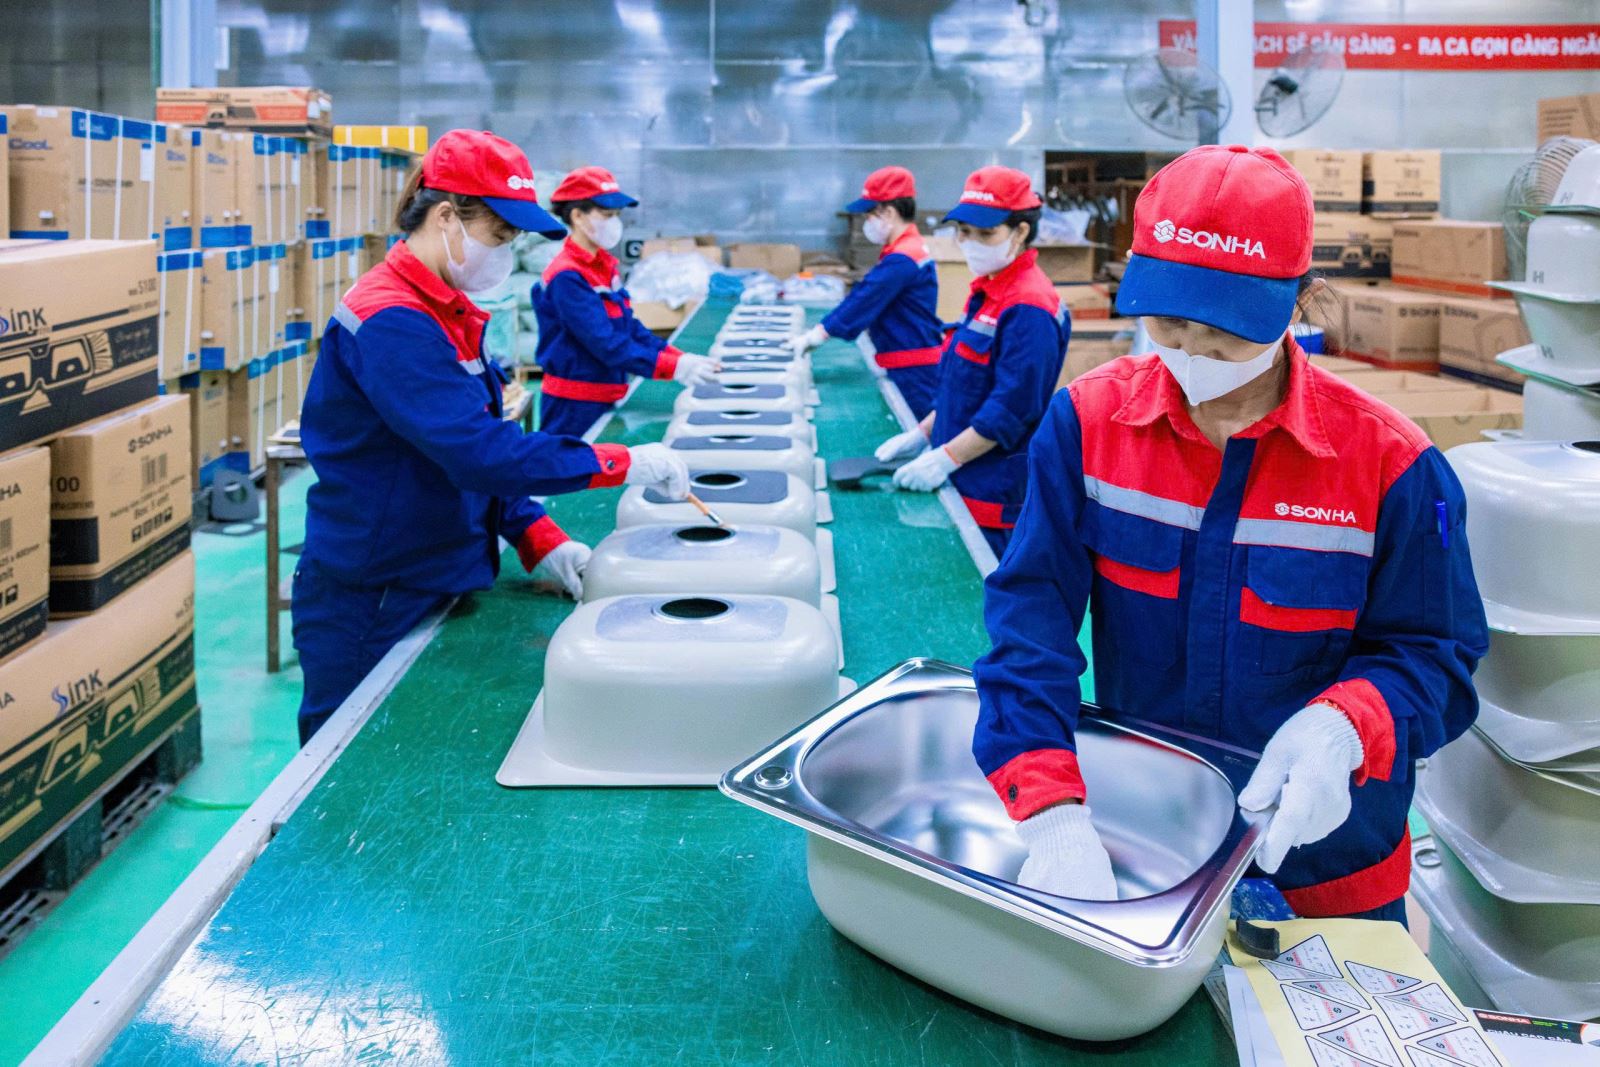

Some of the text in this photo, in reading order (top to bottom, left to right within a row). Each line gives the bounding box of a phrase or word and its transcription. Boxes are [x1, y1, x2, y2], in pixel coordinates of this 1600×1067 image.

[1348, 32, 1396, 55] SÀNG
[1418, 36, 1443, 56] RA
[1444, 36, 1469, 56] CA
[1511, 33, 1559, 56] GÀNG
[1175, 227, 1266, 259] SONHA
[137, 424, 173, 448] SONHA
[1291, 504, 1357, 523] SONHA
